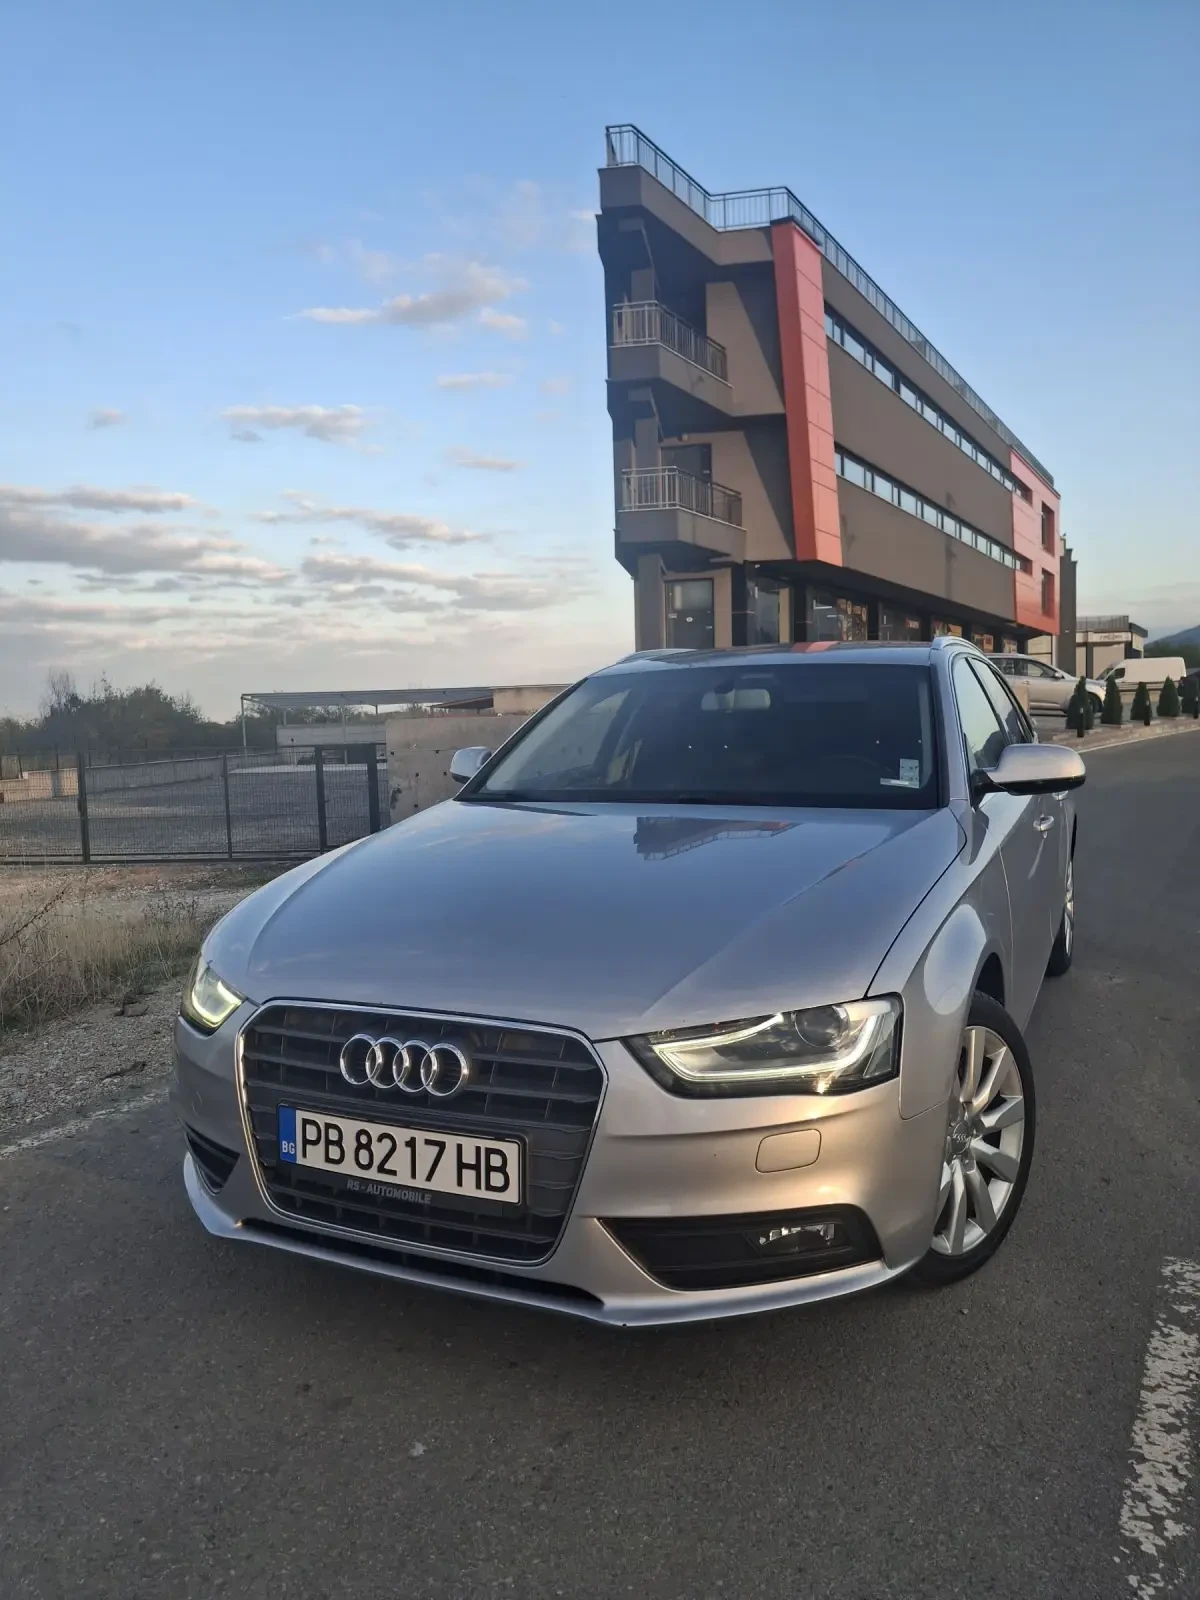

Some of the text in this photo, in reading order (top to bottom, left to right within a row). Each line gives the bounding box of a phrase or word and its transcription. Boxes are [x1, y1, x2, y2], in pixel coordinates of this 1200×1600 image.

[282, 1141, 295, 1154] BG
[301, 1118, 510, 1193] PB 8217 HB
[366, 1184, 432, 1204] AUTOMOBILE
